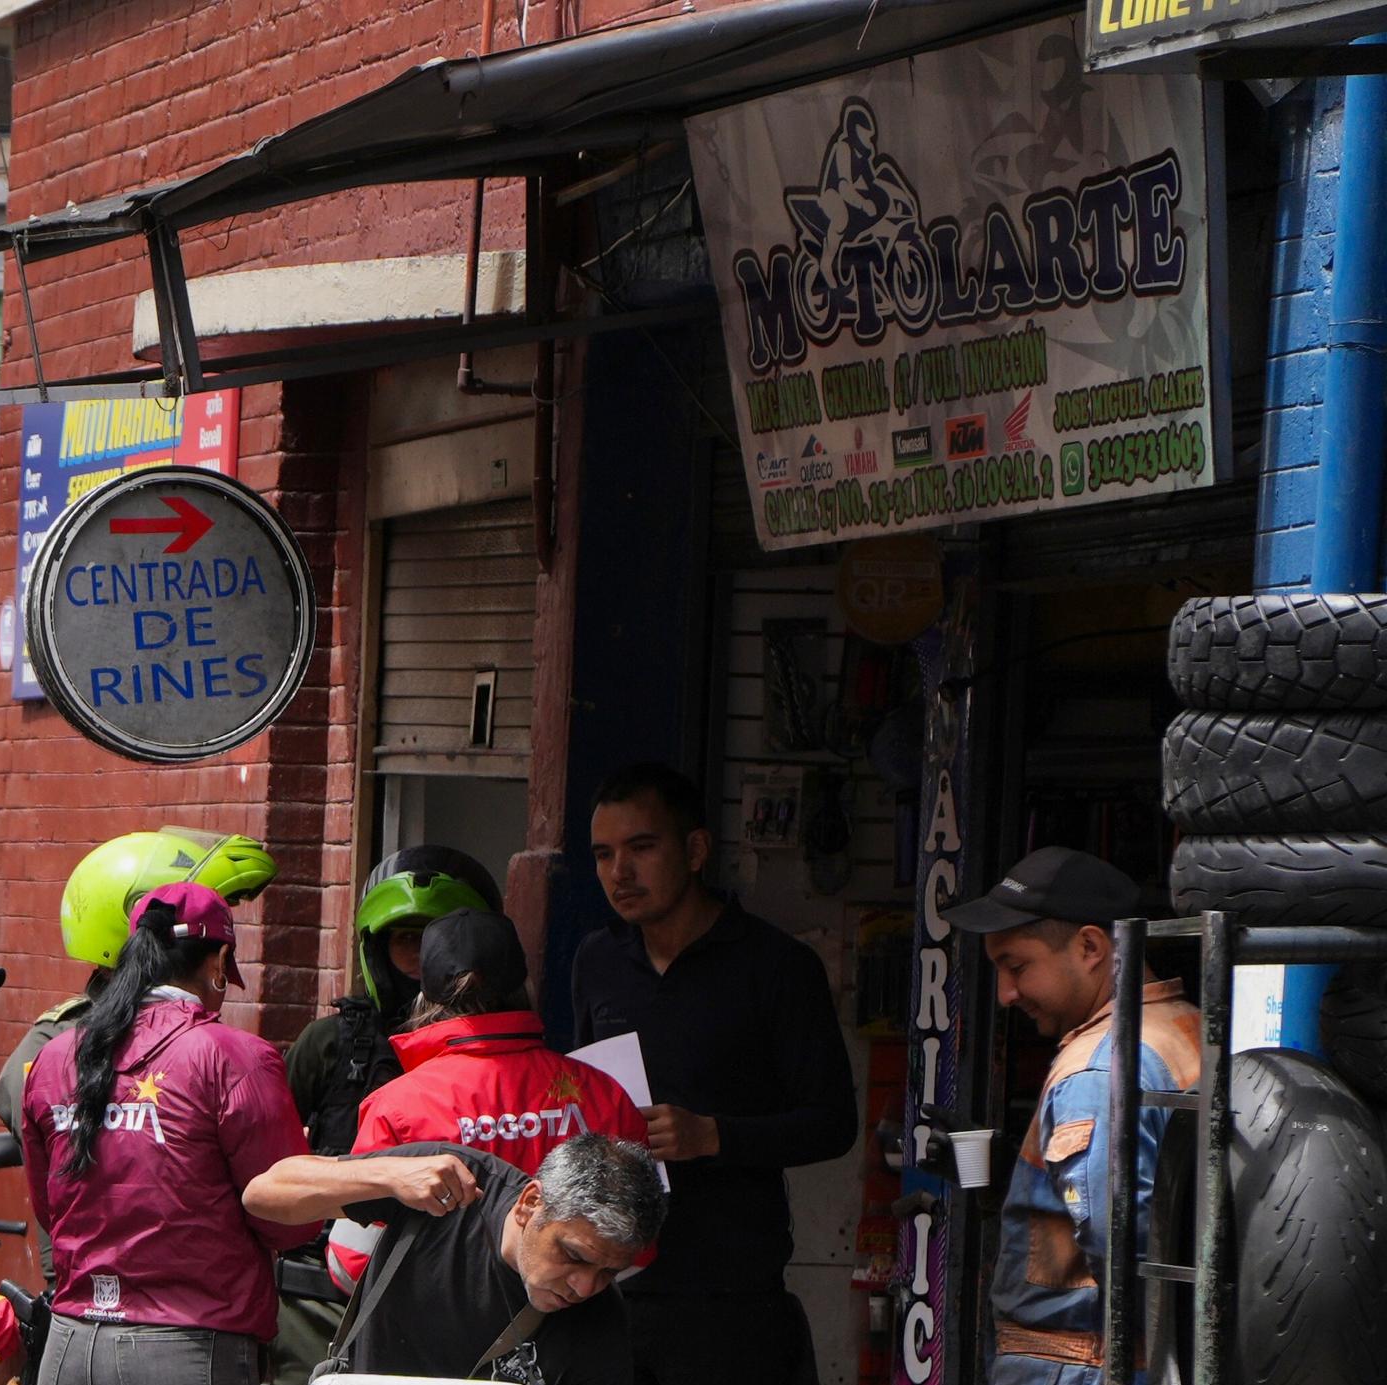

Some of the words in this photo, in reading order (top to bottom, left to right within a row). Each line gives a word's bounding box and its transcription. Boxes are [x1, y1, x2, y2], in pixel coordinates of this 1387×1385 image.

[734, 152, 1185, 372] MOTOLARTE
[821, 358, 890, 422] GENERAL
[1053, 387, 1090, 433] JOSE
[1090, 377, 1147, 427] MIGUEL
[1148, 365, 1205, 415] OLARTE
[844, 451, 878, 477] YAMAHA
[949, 420, 985, 455] KTM
[1088, 420, 1205, 492] 3125231603
[764, 484, 819, 538] CALLE
[974, 450, 1041, 508] LOCAL
[1041, 453, 1055, 500] 2
[65, 556, 267, 607] CENTRADA
[133, 606, 217, 651] DE
[90, 653, 268, 707] RINES
